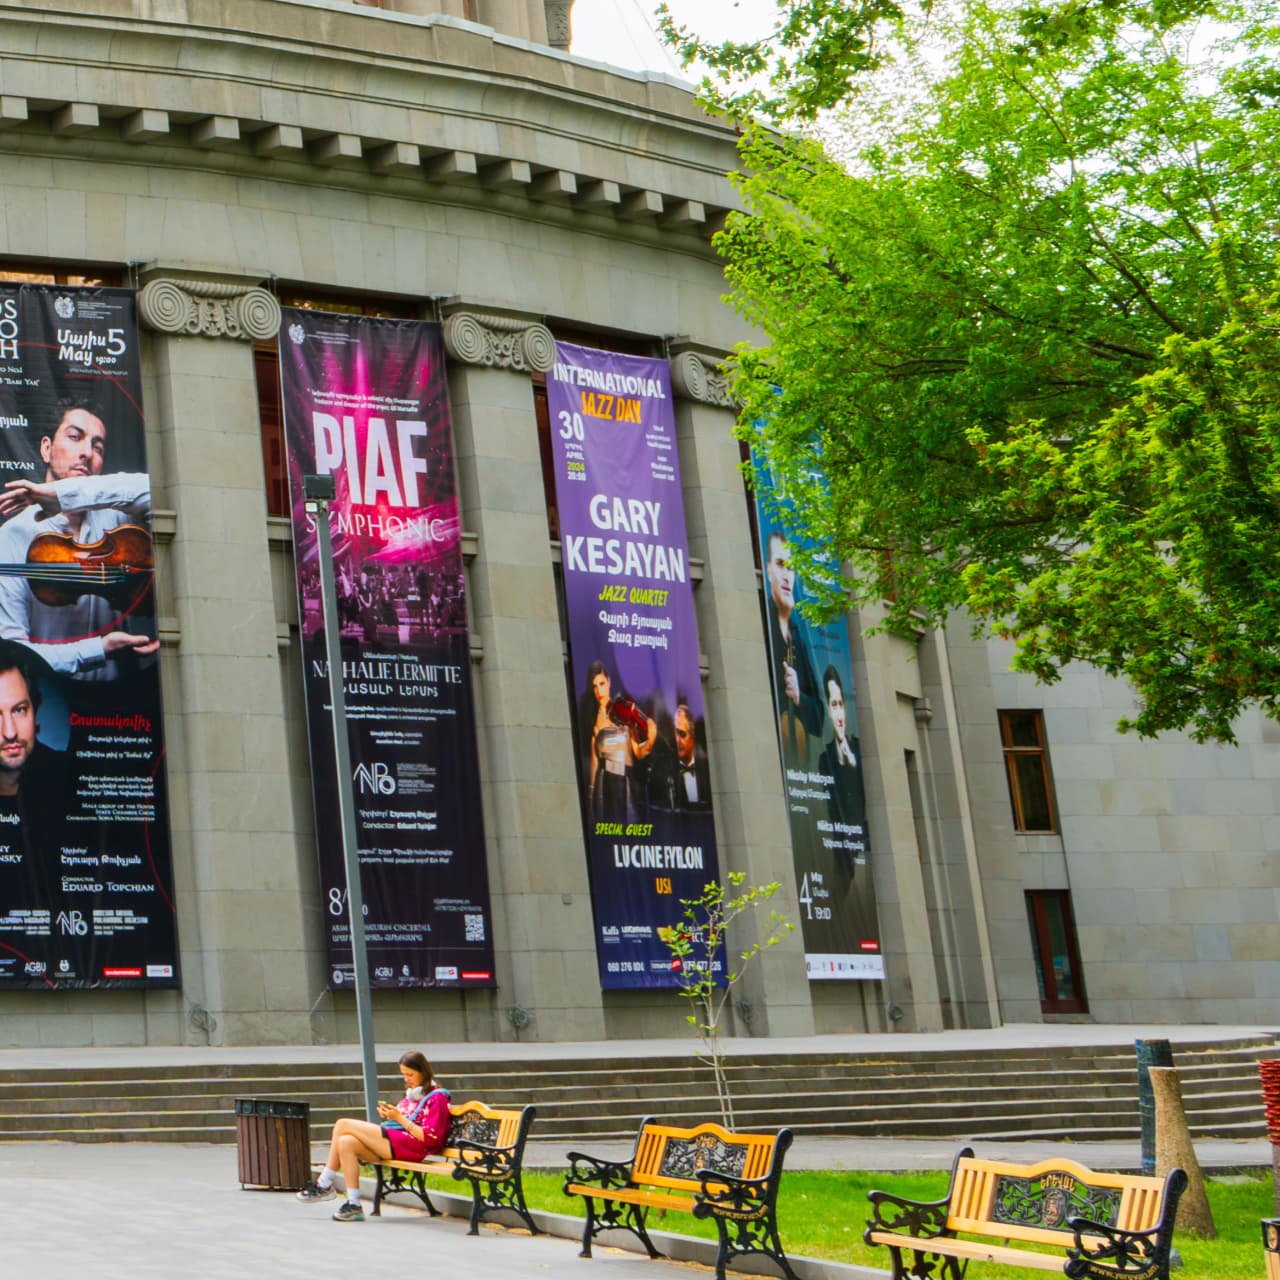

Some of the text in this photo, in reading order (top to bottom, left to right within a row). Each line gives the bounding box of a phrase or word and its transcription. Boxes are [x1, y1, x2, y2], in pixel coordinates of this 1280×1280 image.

[57, 328, 127, 356] Մայիս 5
[58, 345, 94, 366] May
[553, 362, 666, 400] INTERNATIONAL
[581, 391, 642, 424] JAZZ DAY
[558, 410, 585, 442] 30
[312, 411, 428, 508] PIAF
[306, 510, 446, 542] SMPHONIC
[590, 494, 661, 537] GARY
[566, 535, 686, 583] KESAYAN
[599, 584, 669, 607] JAZZ QUARTET
[313, 660, 392, 679] NHALIE
[343, 683, 393, 695] ԱՏԱԼԻ
[595, 822, 653, 836] SPECIAL GUEST
[614, 844, 664, 869] LUCINE
[800, 872, 813, 920] 4
